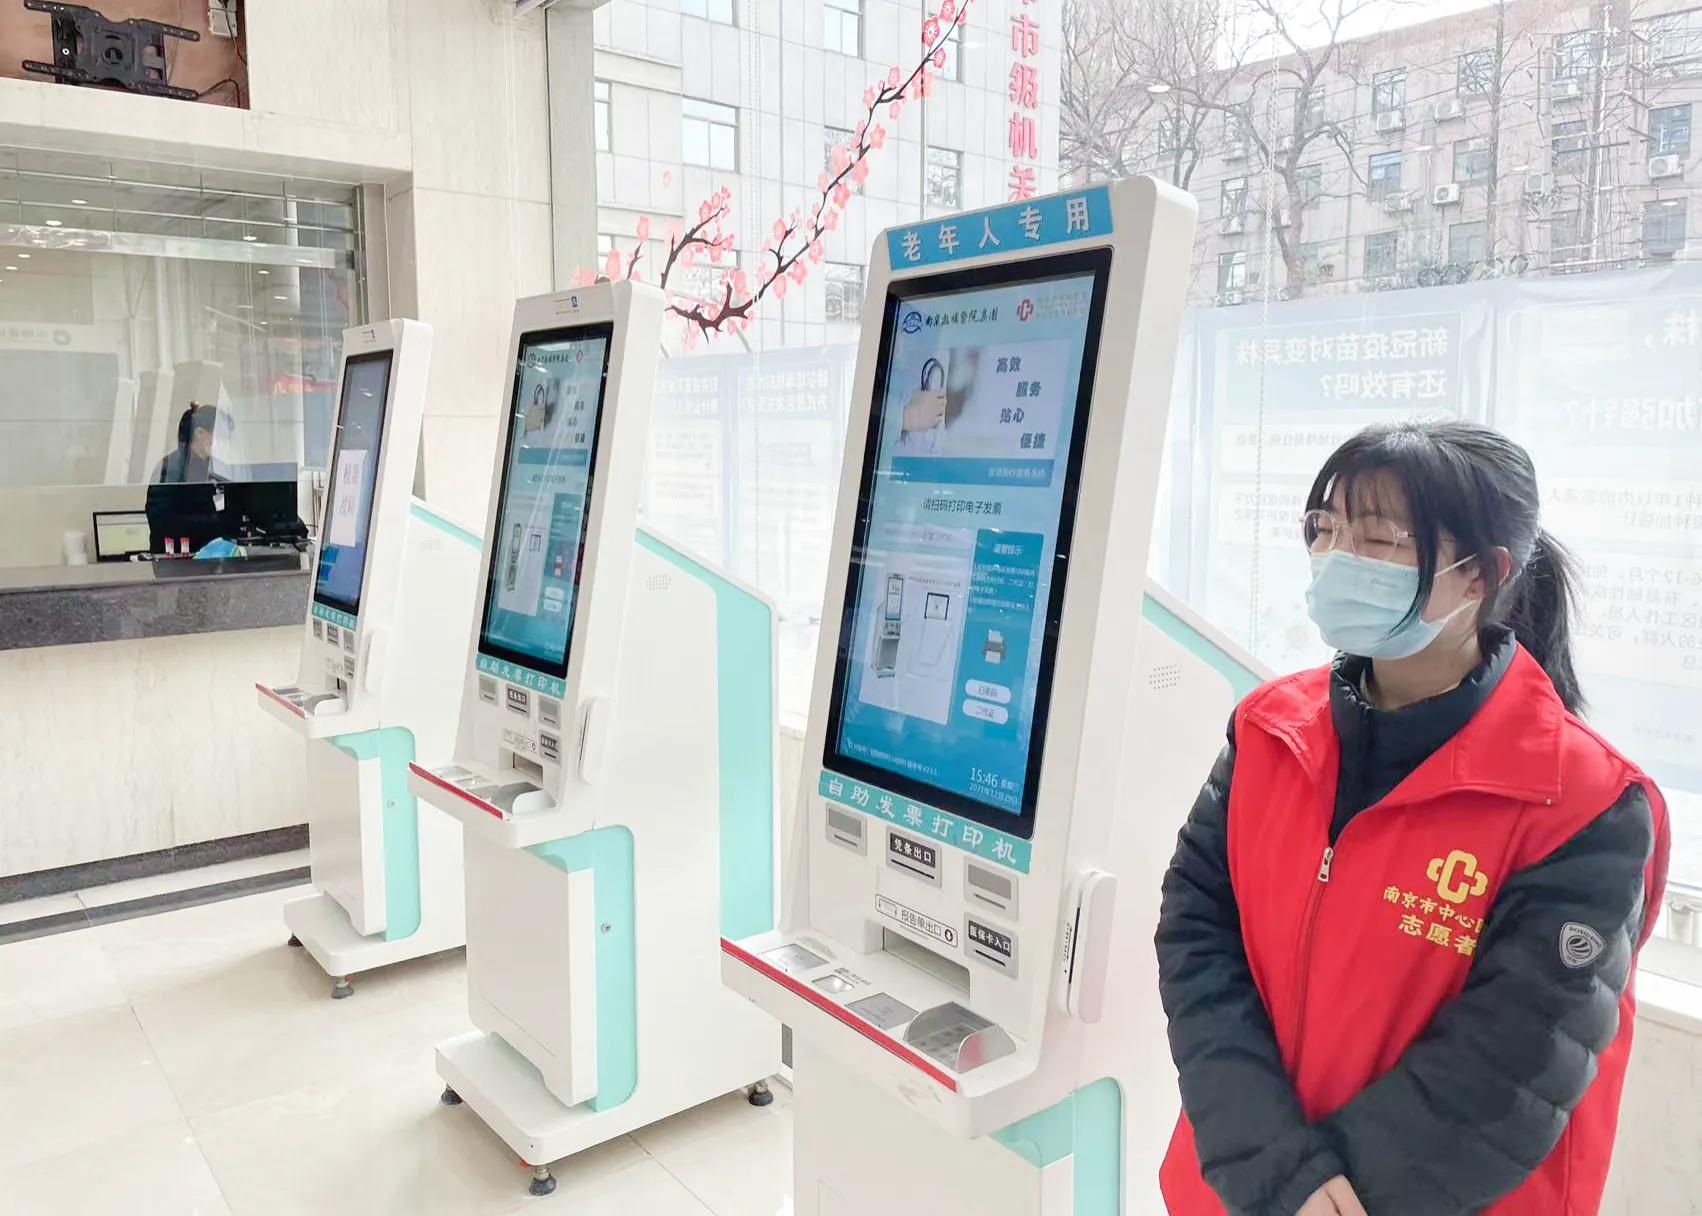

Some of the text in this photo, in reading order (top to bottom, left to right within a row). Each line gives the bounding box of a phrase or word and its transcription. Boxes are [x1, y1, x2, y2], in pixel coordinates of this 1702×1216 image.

[1007, 0, 1040, 201] 市级机关
[902, 196, 1089, 262] 老年人专用
[996, 357, 1022, 373] 高效
[1016, 381, 1041, 397] 服务
[1000, 408, 1025, 423] 贴心
[1020, 433, 1046, 449] 便捷
[922, 498, 1002, 516] 请扫码打印电子发票
[969, 767, 998, 788] 15:46
[828, 779, 1016, 864] 自助发票打印机
[894, 838, 932, 862] 凭条出口
[901, 908, 942, 937] 报告单出口
[1398, 913, 1477, 956] 志愿者
